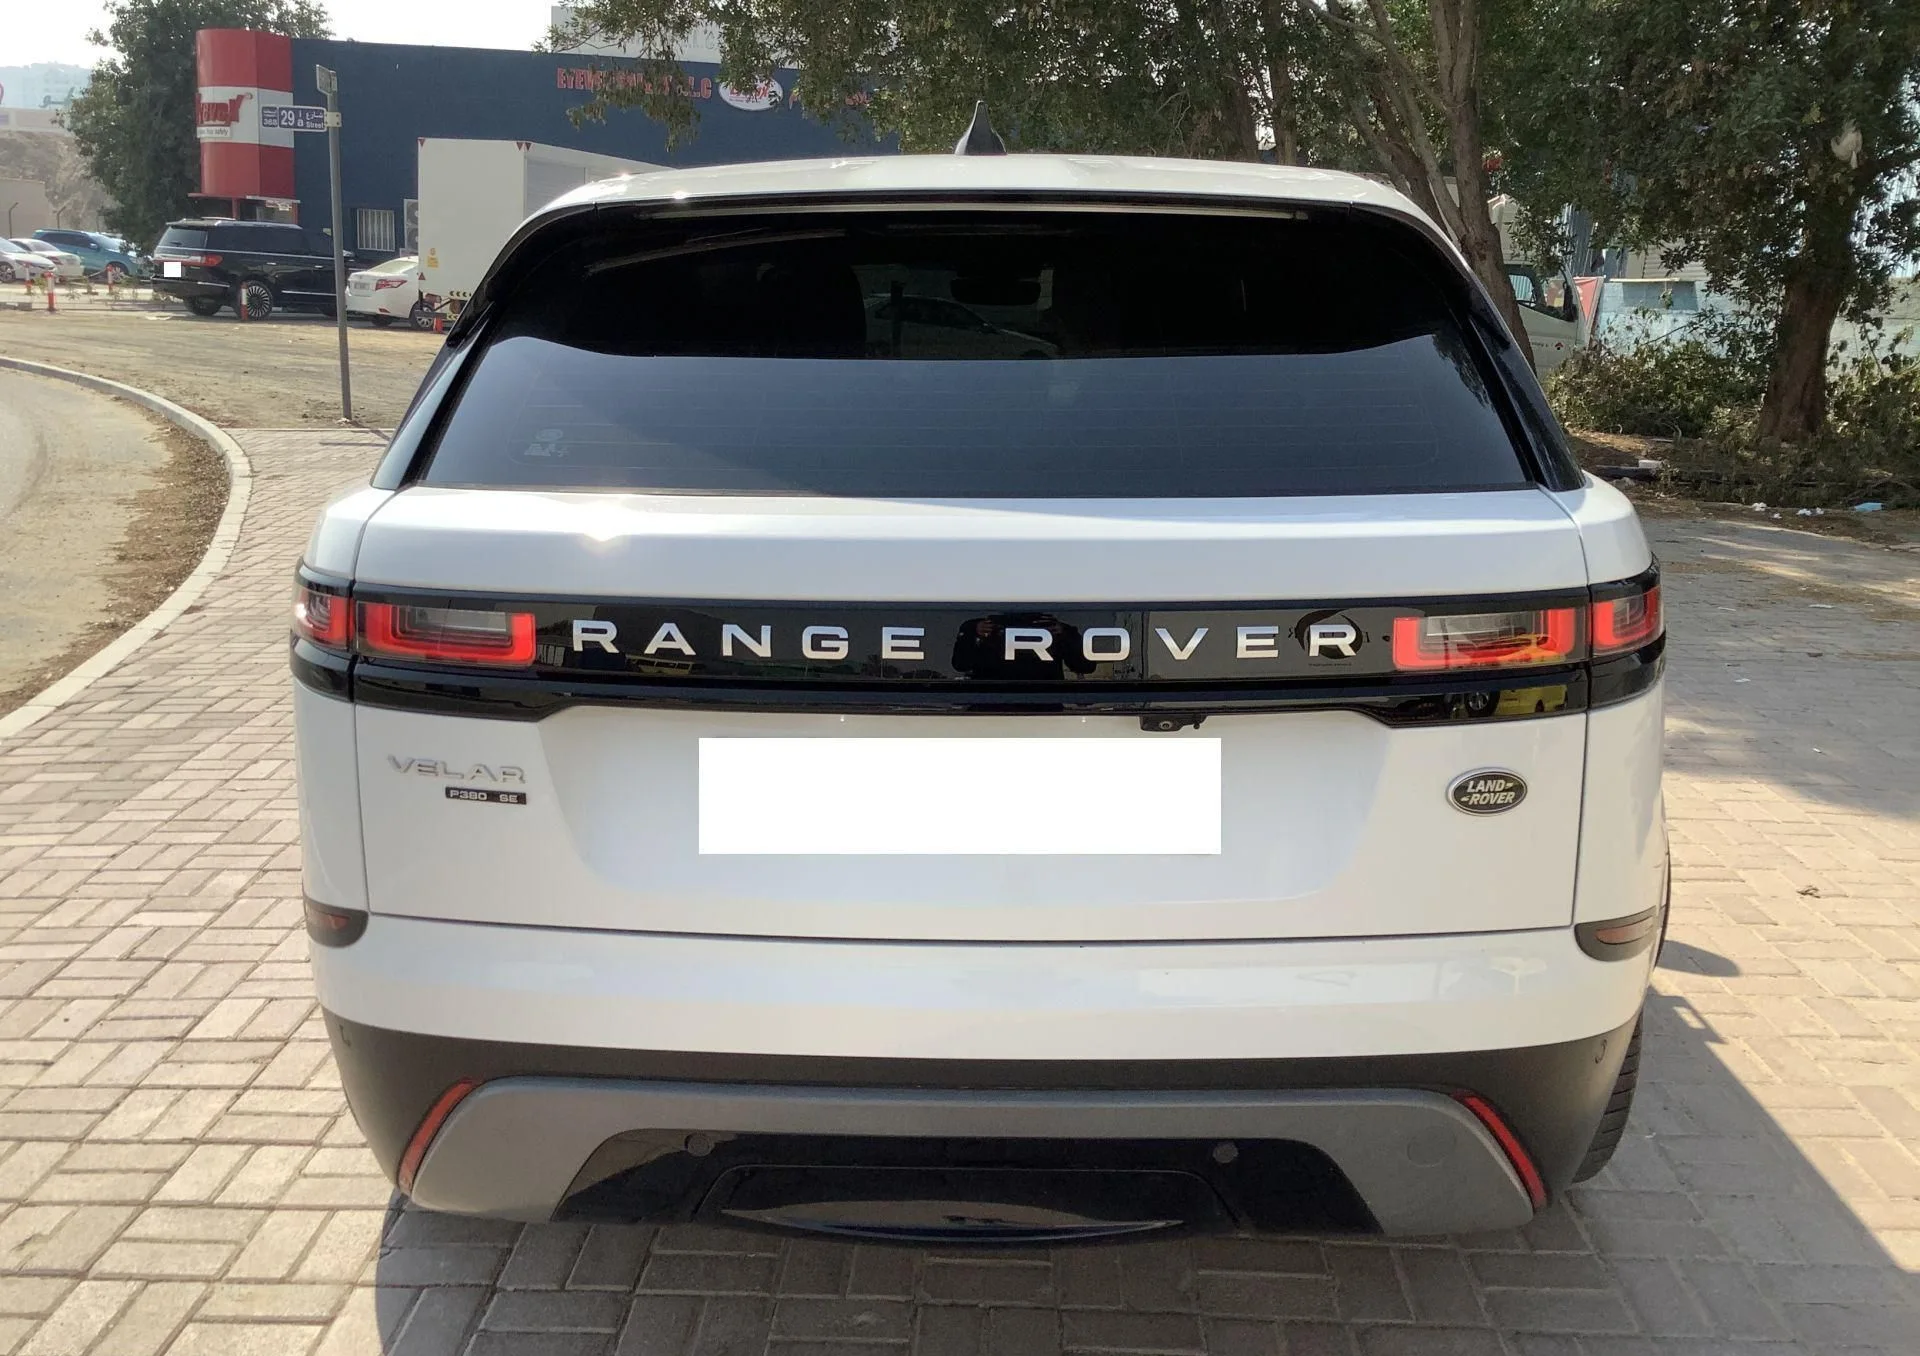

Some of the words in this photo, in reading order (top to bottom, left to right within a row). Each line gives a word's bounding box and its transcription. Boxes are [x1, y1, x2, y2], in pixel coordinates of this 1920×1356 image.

[281, 110, 295, 126] 29
[305, 120, 325, 129] Street
[572, 618, 925, 661] RANGE
[1004, 623, 1358, 662] ROVER
[387, 754, 526, 784] VELAR
[1467, 779, 1506, 793] LAND
[449, 789, 488, 801] P380
[499, 793, 519, 803] SE
[1468, 791, 1516, 805] ROVER
